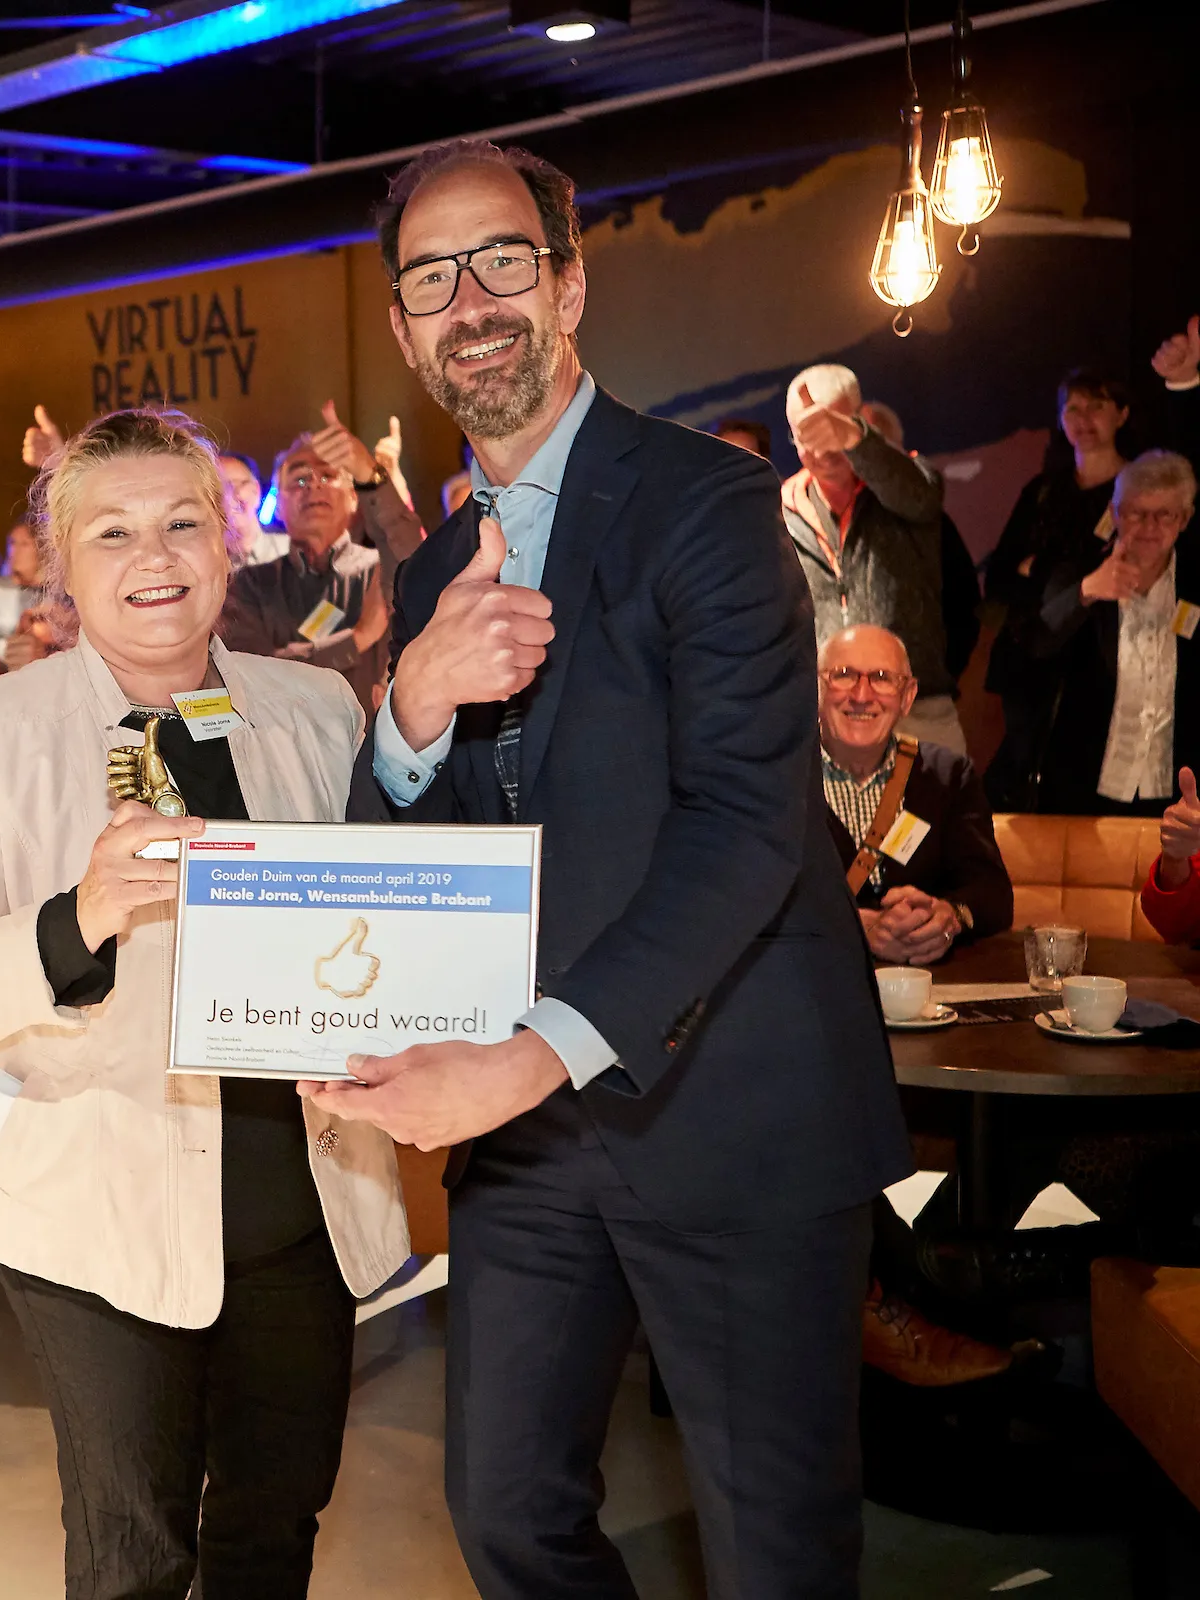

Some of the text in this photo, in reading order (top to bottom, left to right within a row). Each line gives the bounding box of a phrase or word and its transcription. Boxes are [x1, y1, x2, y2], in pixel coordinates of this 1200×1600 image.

[86, 285, 257, 357] VIRTUAL
[92, 341, 257, 414] REALITY
[211, 868, 452, 888] Gouden Duim van de maand april 2019
[210, 887, 492, 906] Nicole Jorna, Wensambulance Brabant
[206, 998, 487, 1034] Je bent goud waard!
